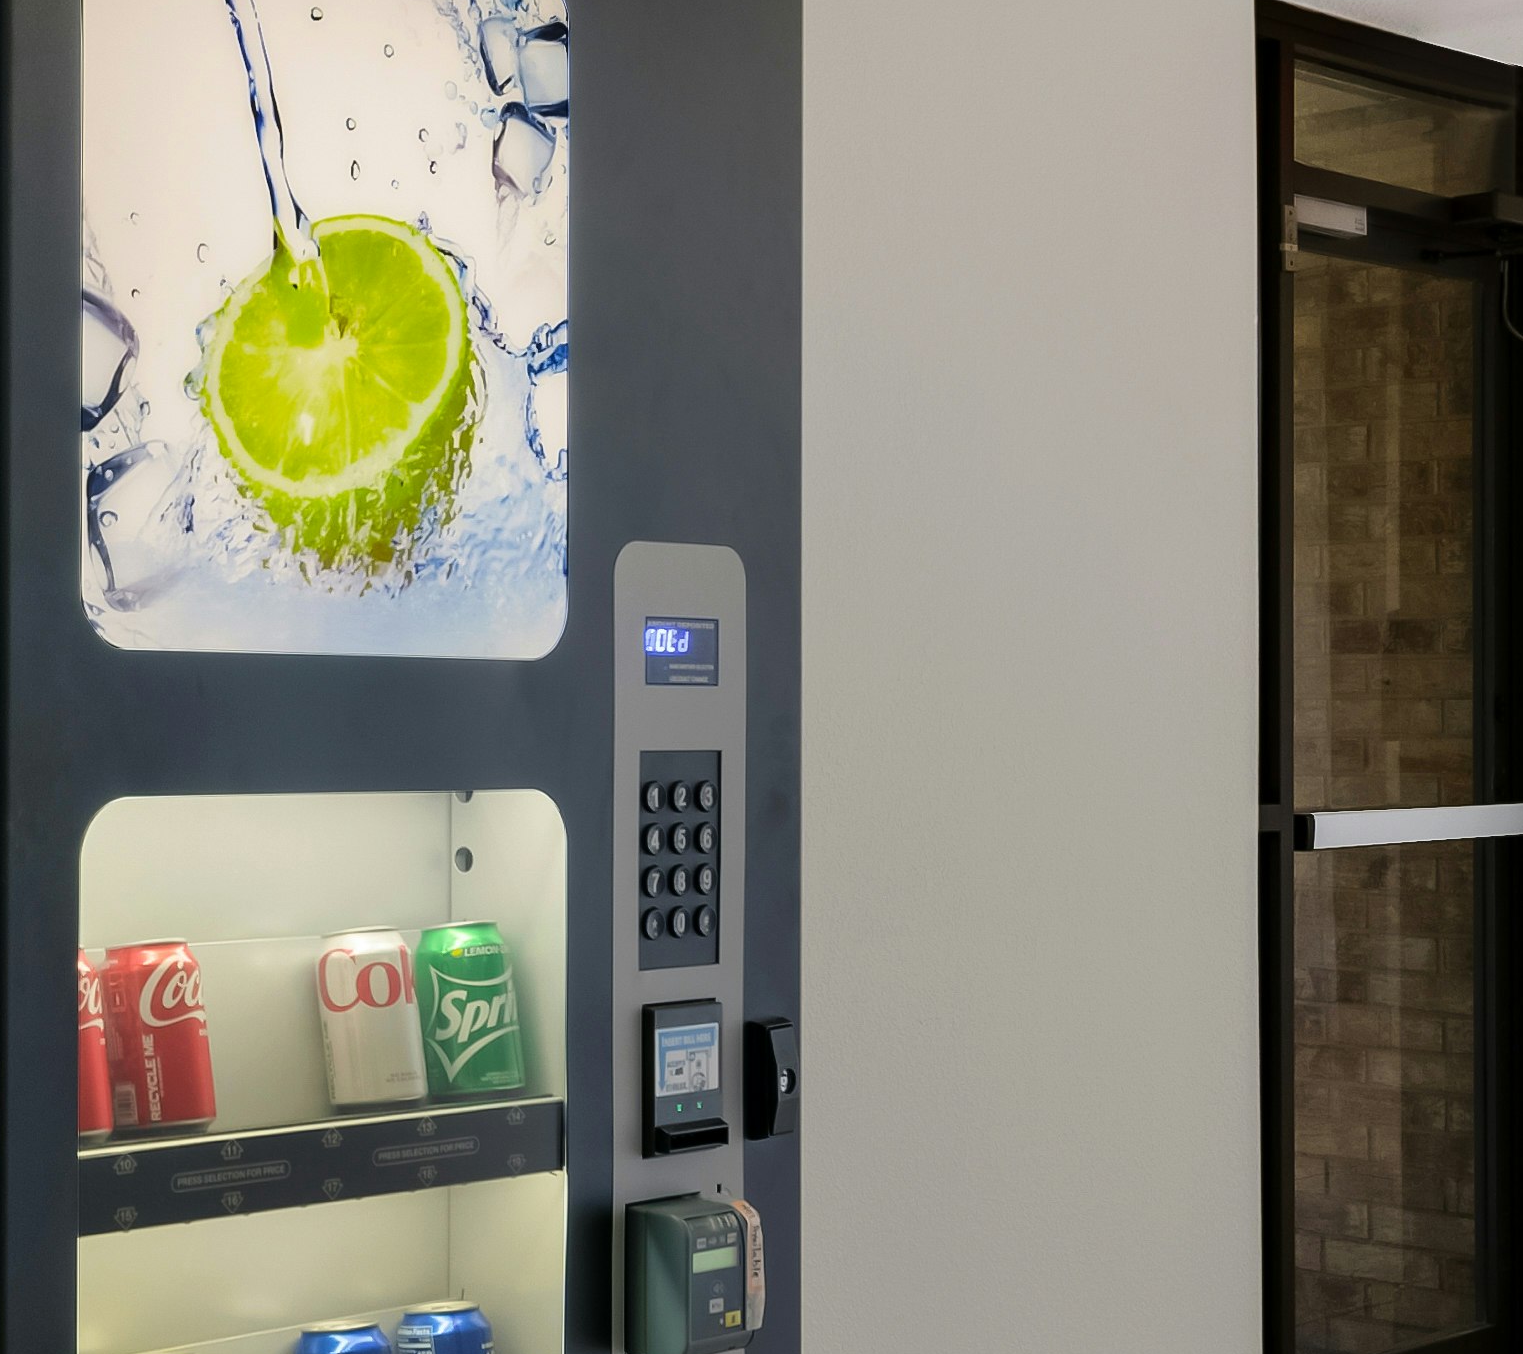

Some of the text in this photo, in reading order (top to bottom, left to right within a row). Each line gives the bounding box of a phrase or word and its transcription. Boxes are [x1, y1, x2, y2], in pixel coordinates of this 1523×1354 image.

[651, 787, 660, 808] 1
[676, 786, 687, 807] 2
[703, 786, 713, 807] 3
[650, 829, 660, 851] 4
[677, 828, 687, 849] 5
[702, 827, 712, 848] 6
[651, 871, 661, 893] 7
[676, 870, 687, 891] 8
[702, 868, 712, 890] 9
[677, 912, 686, 934] 0
[142, 1033, 162, 1122] RECYCLE ME
[420, 1121, 433, 1134] 13
[510, 1111, 523, 1124] 14
[326, 1133, 339, 1146] 12
[226, 1145, 239, 1158] 11
[378, 1149, 400, 1162] PRESS
[401, 1145, 440, 1160] SELECTION
[455, 1140, 475, 1153] PRICE
[118, 1158, 133, 1172] 10
[177, 1164, 286, 1188] PRESS SELECTION FOR PRICE
[326, 1182, 339, 1195] 17
[226, 1195, 239, 1207] 16
[118, 1210, 133, 1224] 15
